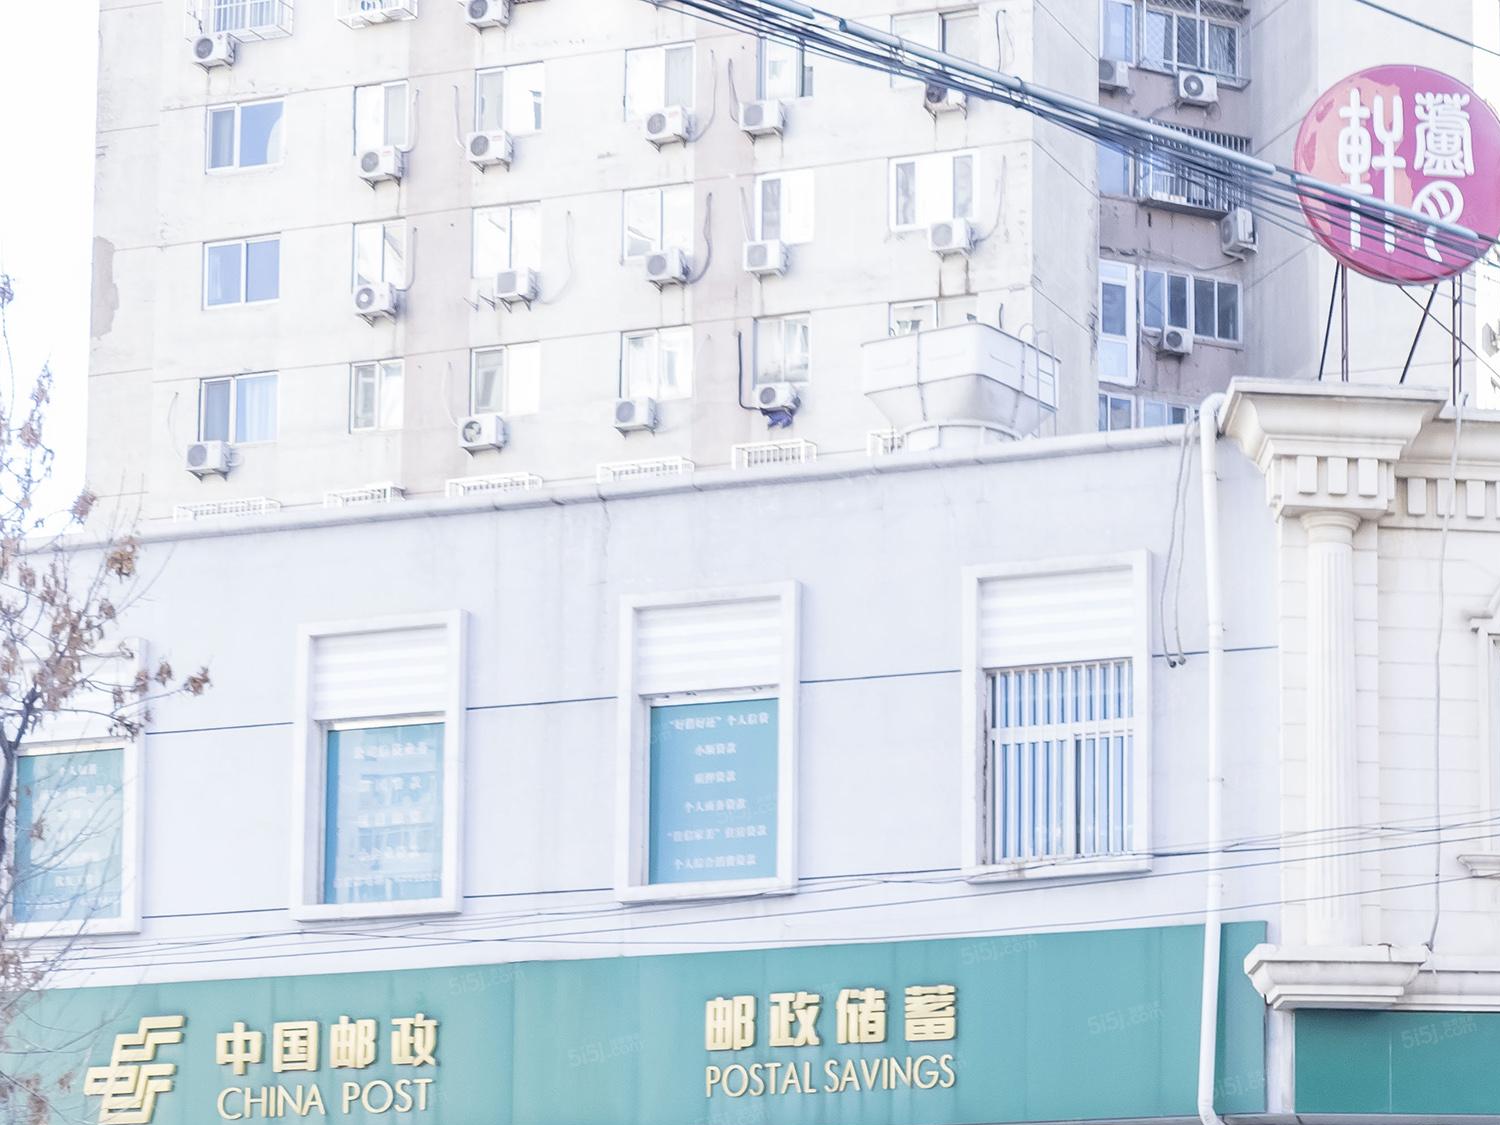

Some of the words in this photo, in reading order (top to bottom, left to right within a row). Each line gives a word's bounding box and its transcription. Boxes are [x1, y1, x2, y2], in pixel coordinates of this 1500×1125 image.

[215, 1012, 440, 1076] 中国邮政
[705, 984, 956, 1052] 邮政储蓄
[216, 1083, 327, 1121] CHINA
[341, 1077, 435, 1115] POST
[705, 1060, 818, 1098] POSTAL
[823, 1054, 956, 1093] SAVINGS
